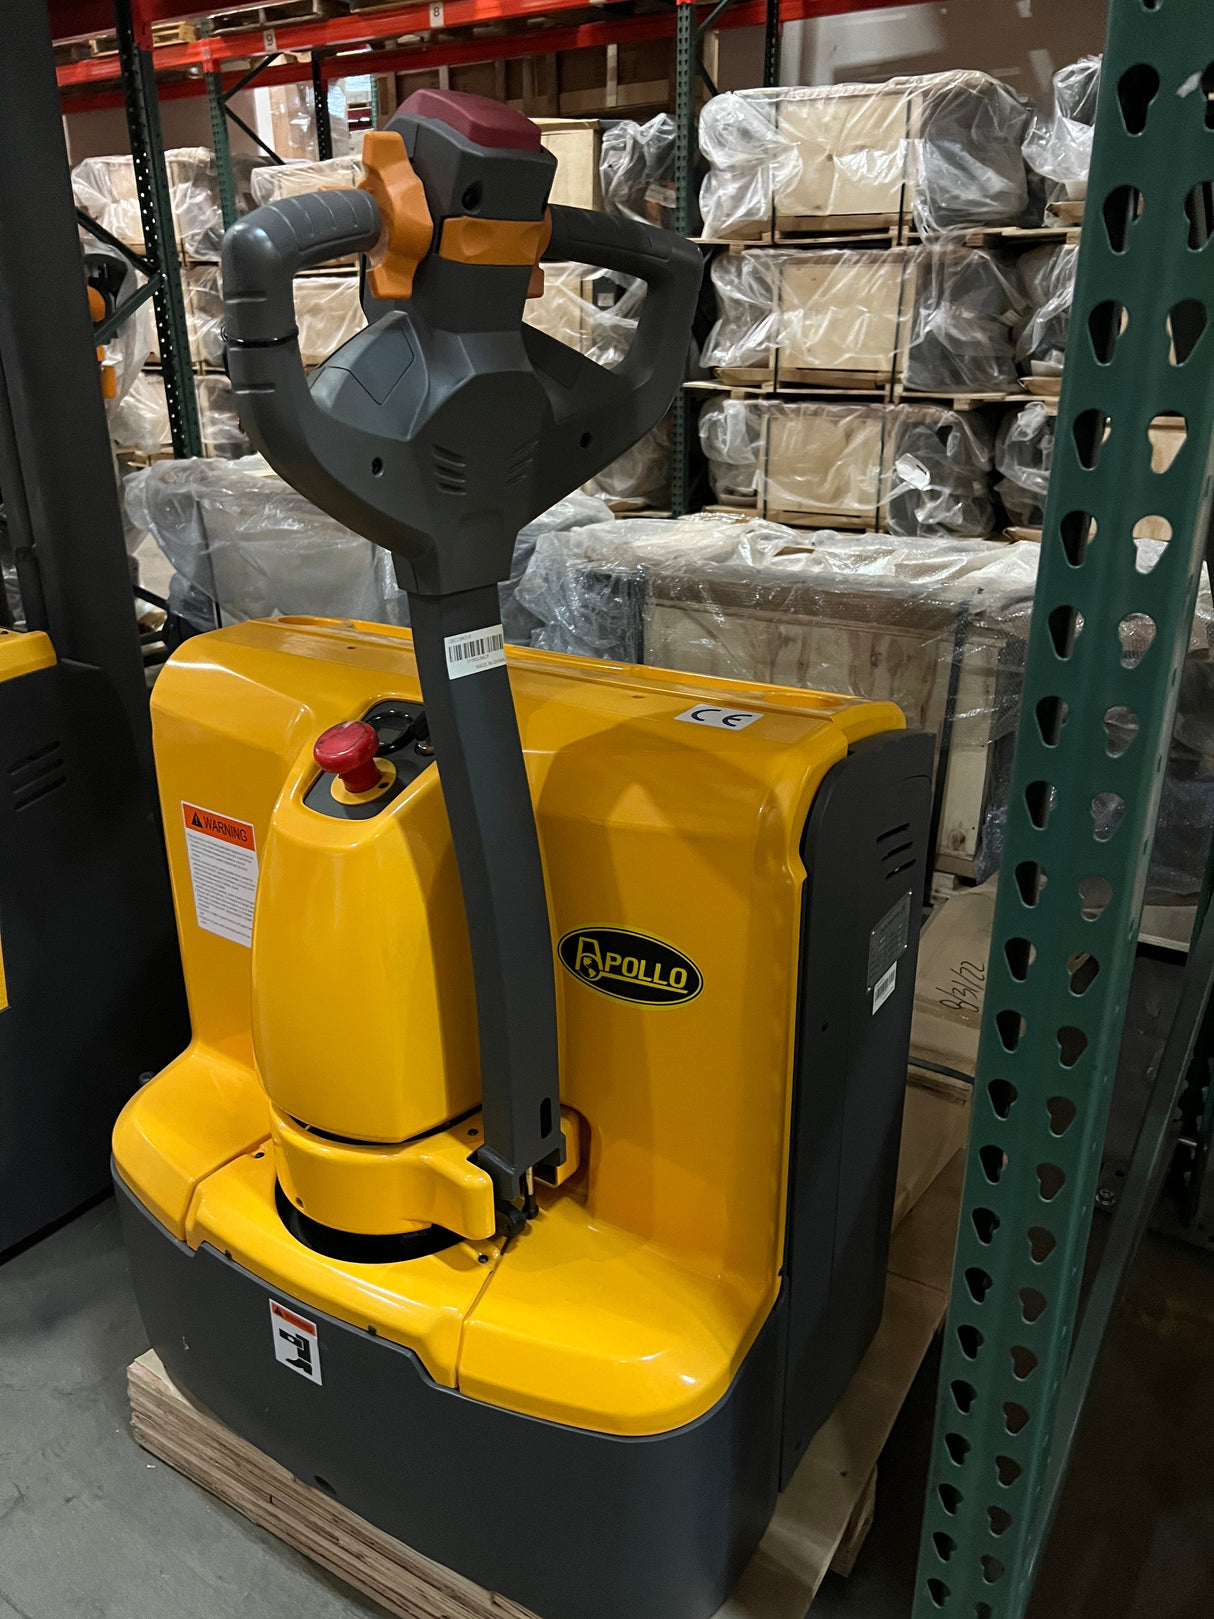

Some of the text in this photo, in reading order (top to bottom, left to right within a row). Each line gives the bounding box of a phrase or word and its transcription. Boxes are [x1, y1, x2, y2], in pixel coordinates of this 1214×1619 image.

[433, 6, 440, 17] 8
[266, 33, 274, 46] 9
[690, 708, 753, 727] CE
[203, 815, 248, 843] WARNING
[575, 936, 688, 989] APOLLO
[936, 961, 985, 1013] 8/31/22
